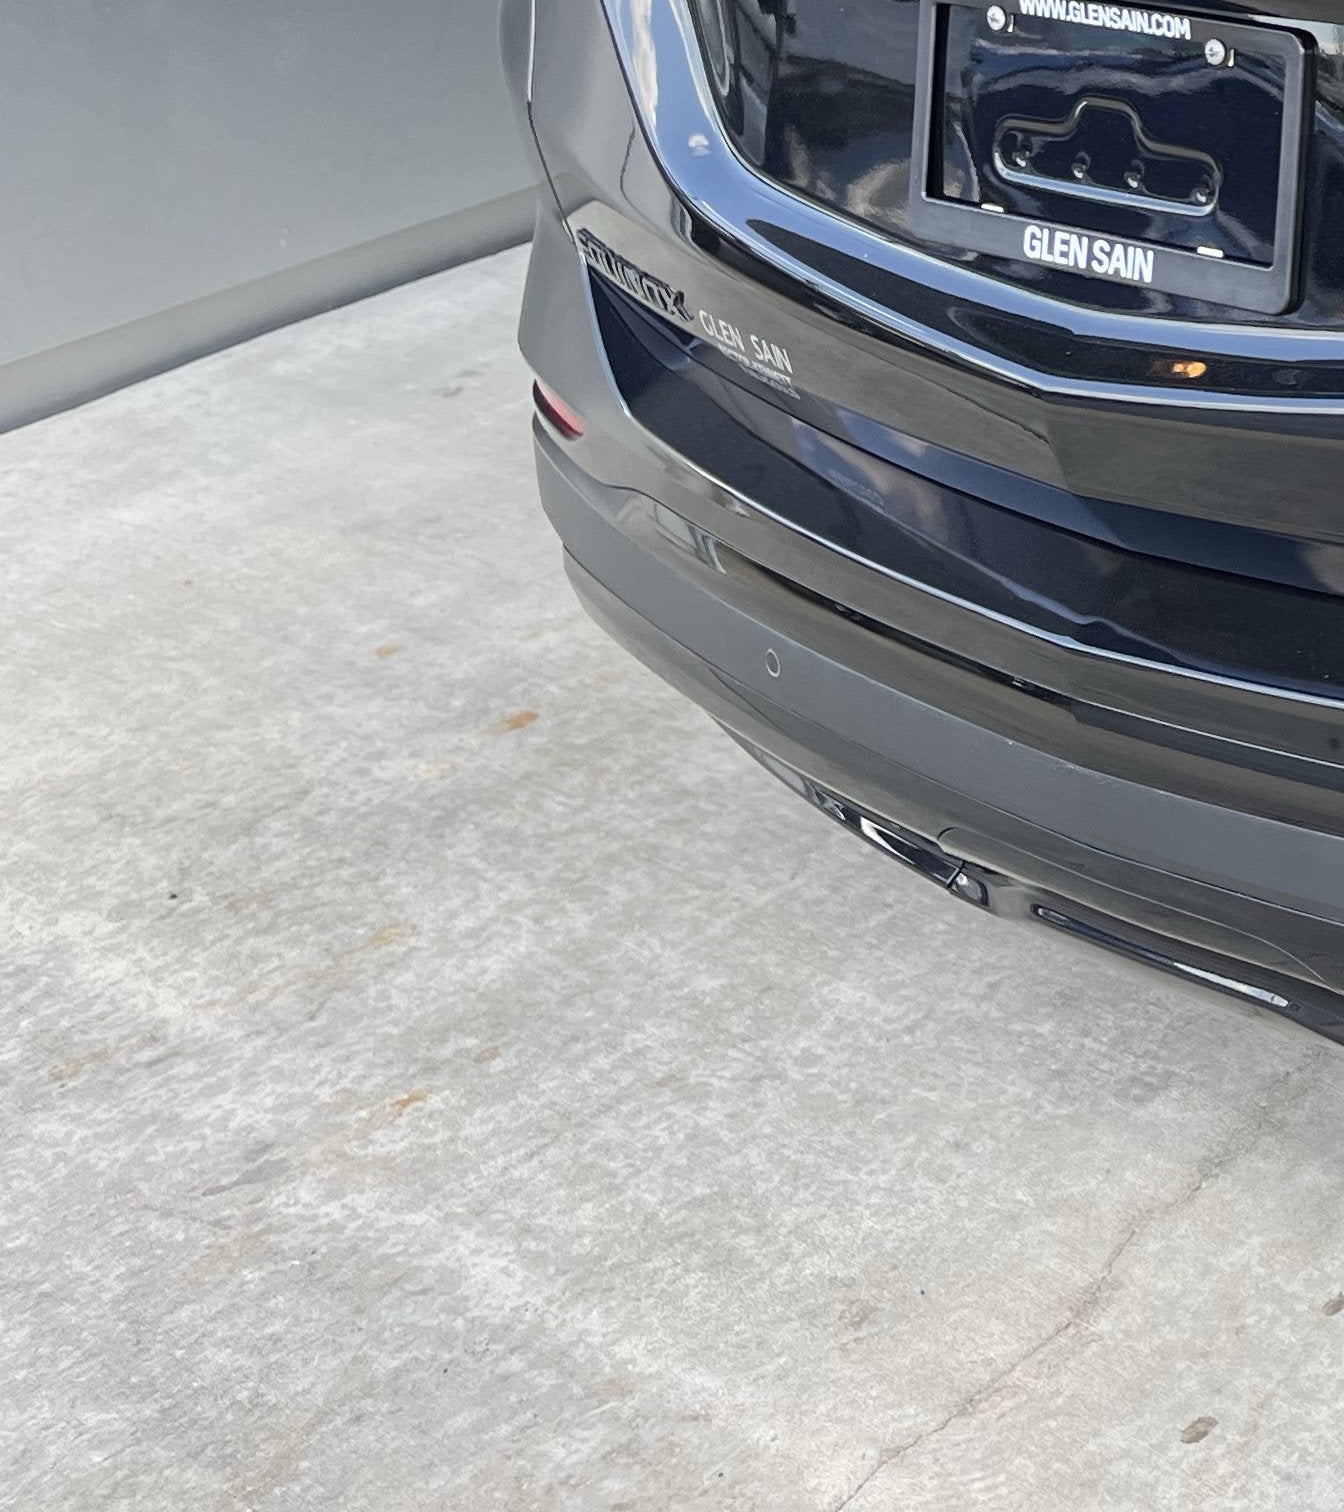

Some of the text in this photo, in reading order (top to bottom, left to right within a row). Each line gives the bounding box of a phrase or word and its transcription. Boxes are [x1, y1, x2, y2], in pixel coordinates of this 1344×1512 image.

[1023, 224, 1155, 283] GLEN SAIN
[699, 309, 746, 353] GLEN
[749, 334, 794, 375] SAIN
